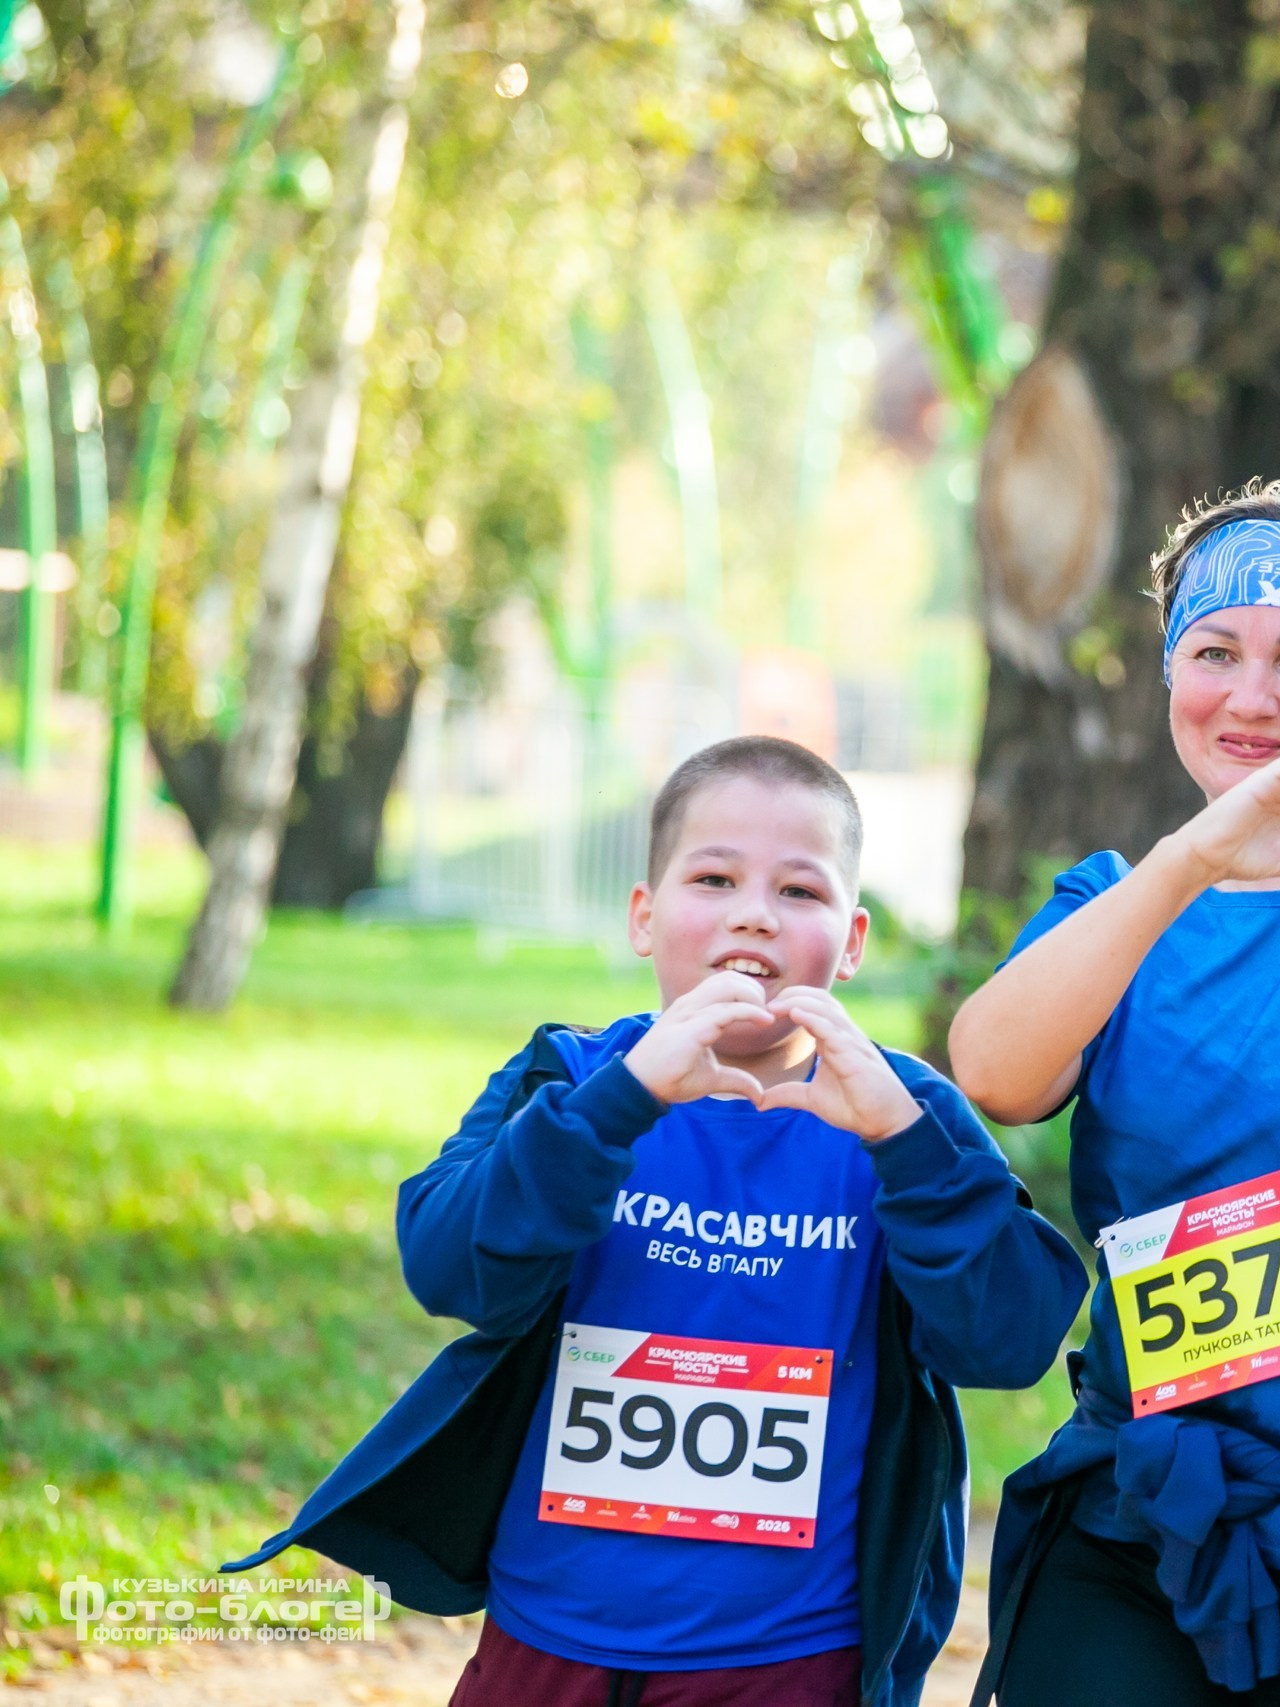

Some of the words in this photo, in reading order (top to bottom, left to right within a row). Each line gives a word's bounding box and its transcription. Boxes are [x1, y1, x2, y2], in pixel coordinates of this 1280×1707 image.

[1187, 1188, 1277, 1226] КРАСНОЯРСКИЕ
[612, 1189, 859, 1250] КРАСАВЧИК
[1212, 1207, 1255, 1229] МОСТЫ
[1216, 1220, 1255, 1236] МАРАФОН
[1135, 1233, 1167, 1252] СБЕР
[646, 1239, 703, 1269] ВЕСЬ
[582, 1350, 616, 1364] СБЕР
[648, 1346, 748, 1367] КРАСНОЯРСКИЕ
[1183, 1330, 1253, 1363] ПУЧКОВА
[673, 1360, 720, 1375] МОСТЫ
[777, 1365, 787, 1378] 5
[788, 1366, 813, 1380] КМ
[560, 1386, 810, 1484] 5905
[756, 1519, 791, 1533] 2026
